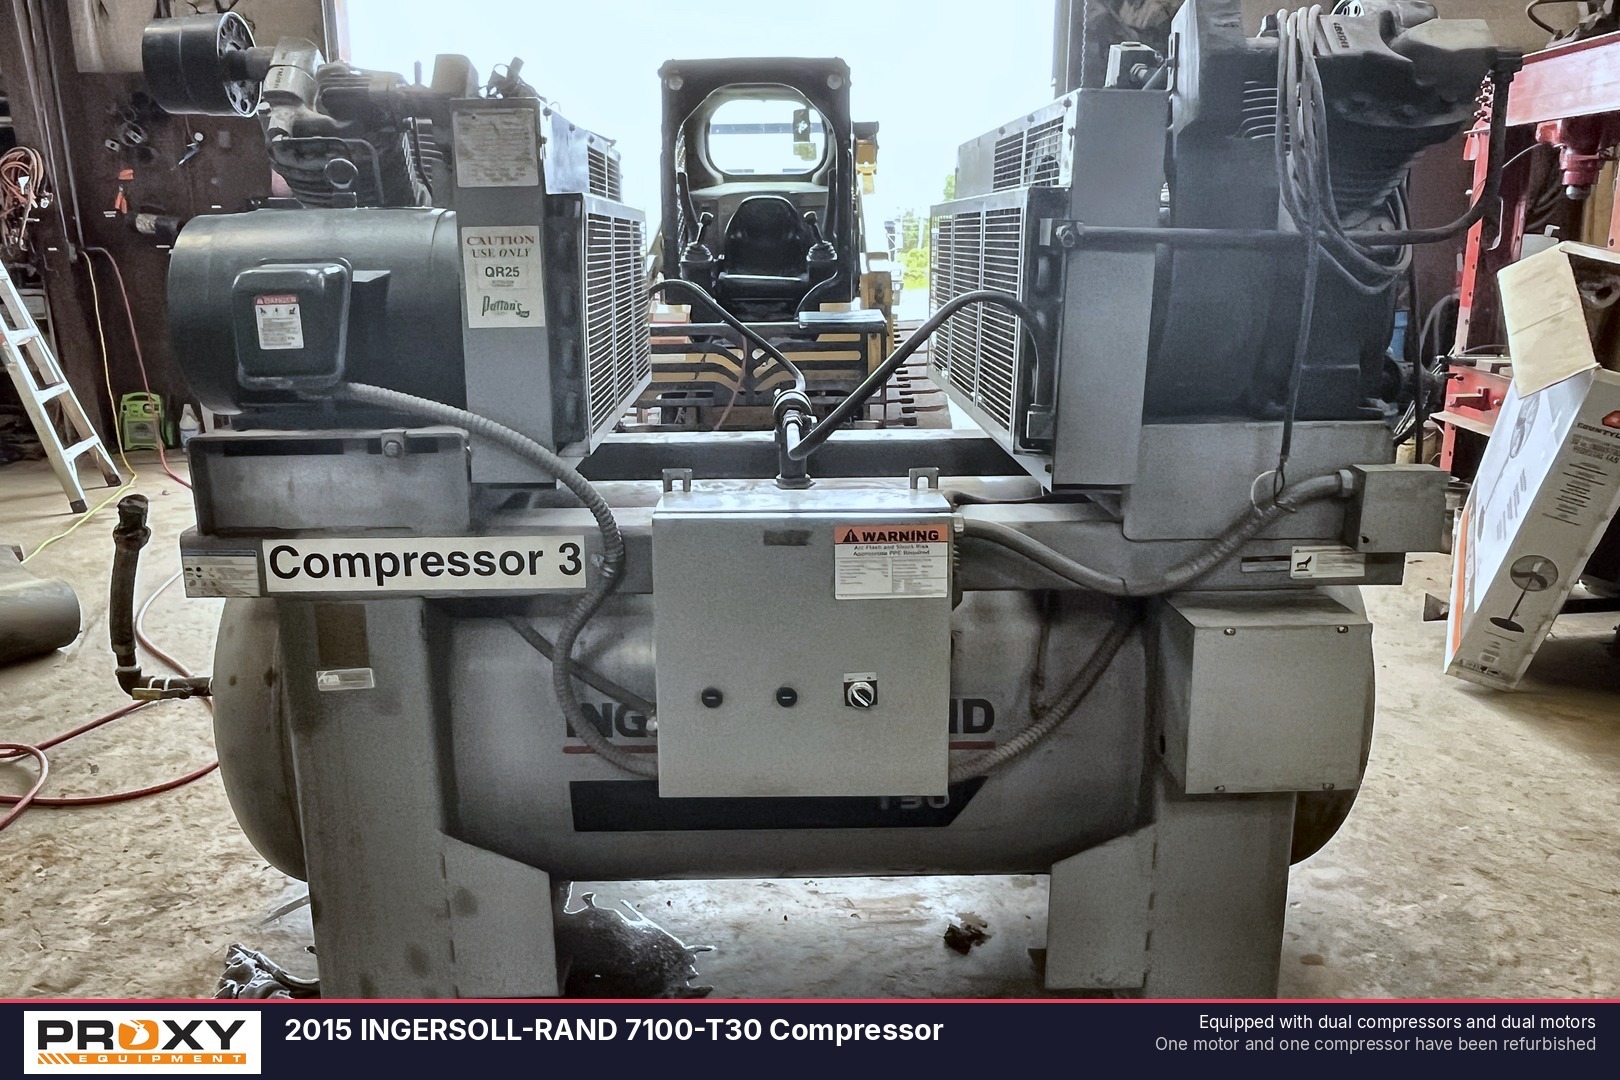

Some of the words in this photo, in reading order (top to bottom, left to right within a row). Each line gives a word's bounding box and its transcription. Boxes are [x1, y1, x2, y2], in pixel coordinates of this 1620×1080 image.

[466, 235, 535, 246] CAUTION
[471, 248, 496, 259] USE
[499, 247, 531, 258] ONLY
[485, 266, 520, 278] QR25
[862, 530, 939, 542] WARNING
[269, 544, 544, 586] Compressor
[558, 543, 582, 576] 3
